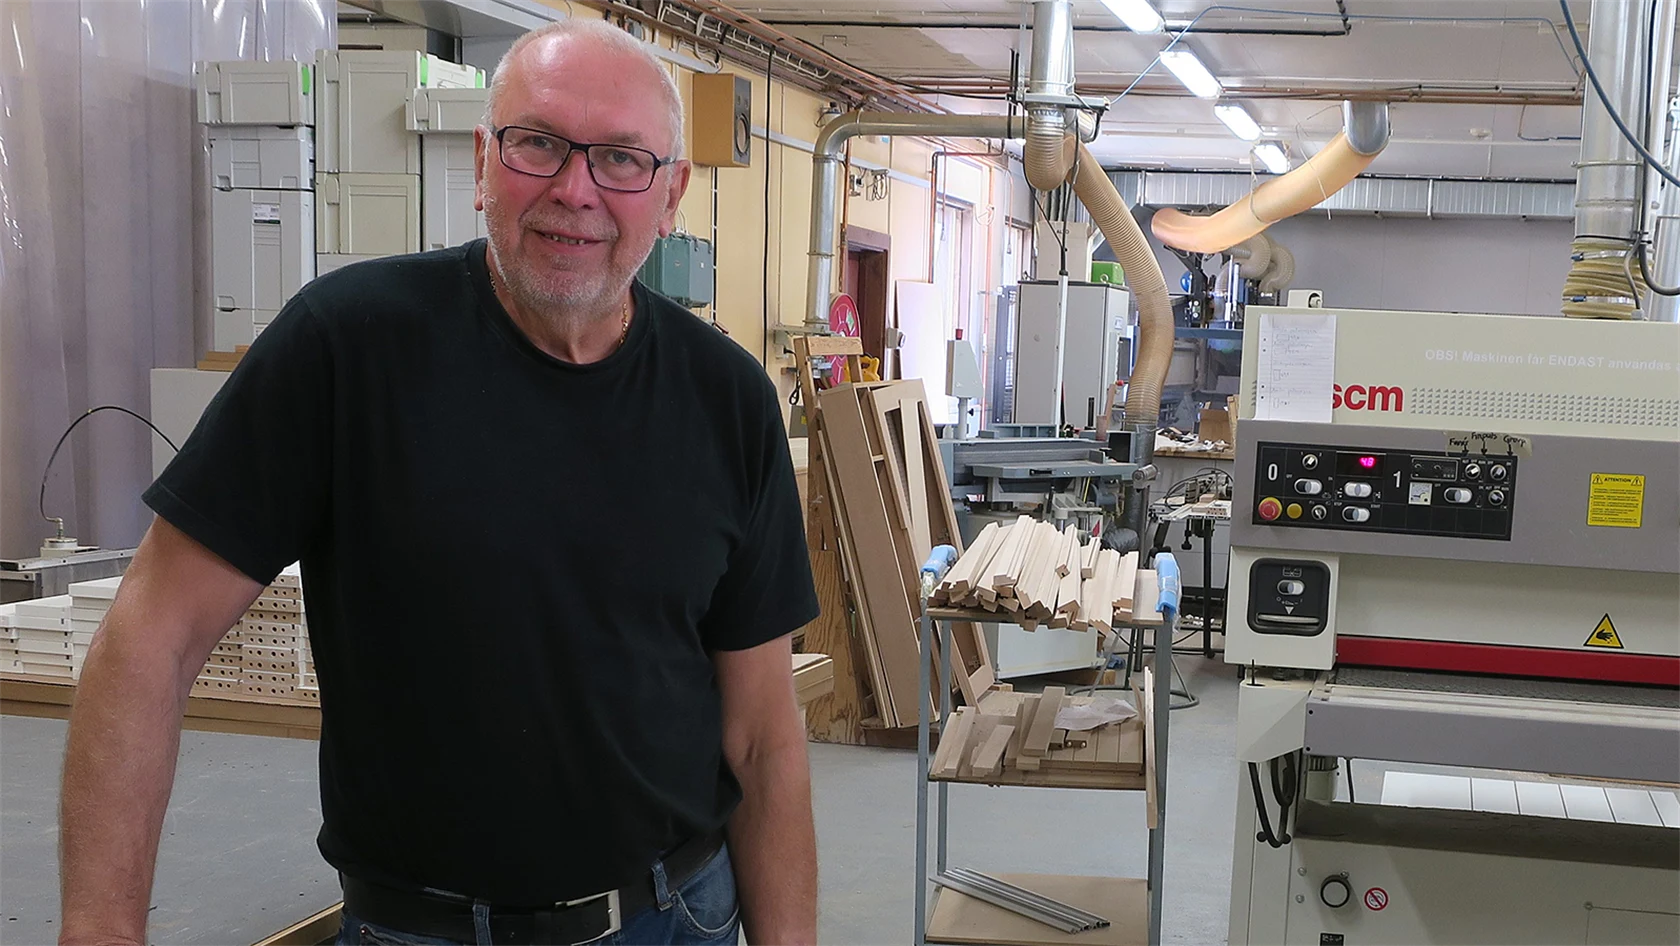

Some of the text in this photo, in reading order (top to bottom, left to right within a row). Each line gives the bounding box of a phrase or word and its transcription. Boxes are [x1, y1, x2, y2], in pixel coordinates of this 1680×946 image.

[1425, 349, 1459, 361] OBS!
[1462, 350, 1523, 364] Maskinen
[1548, 354, 1605, 368] ENDAST
[1267, 463, 1278, 481] 0
[1393, 470, 1401, 488] 1
